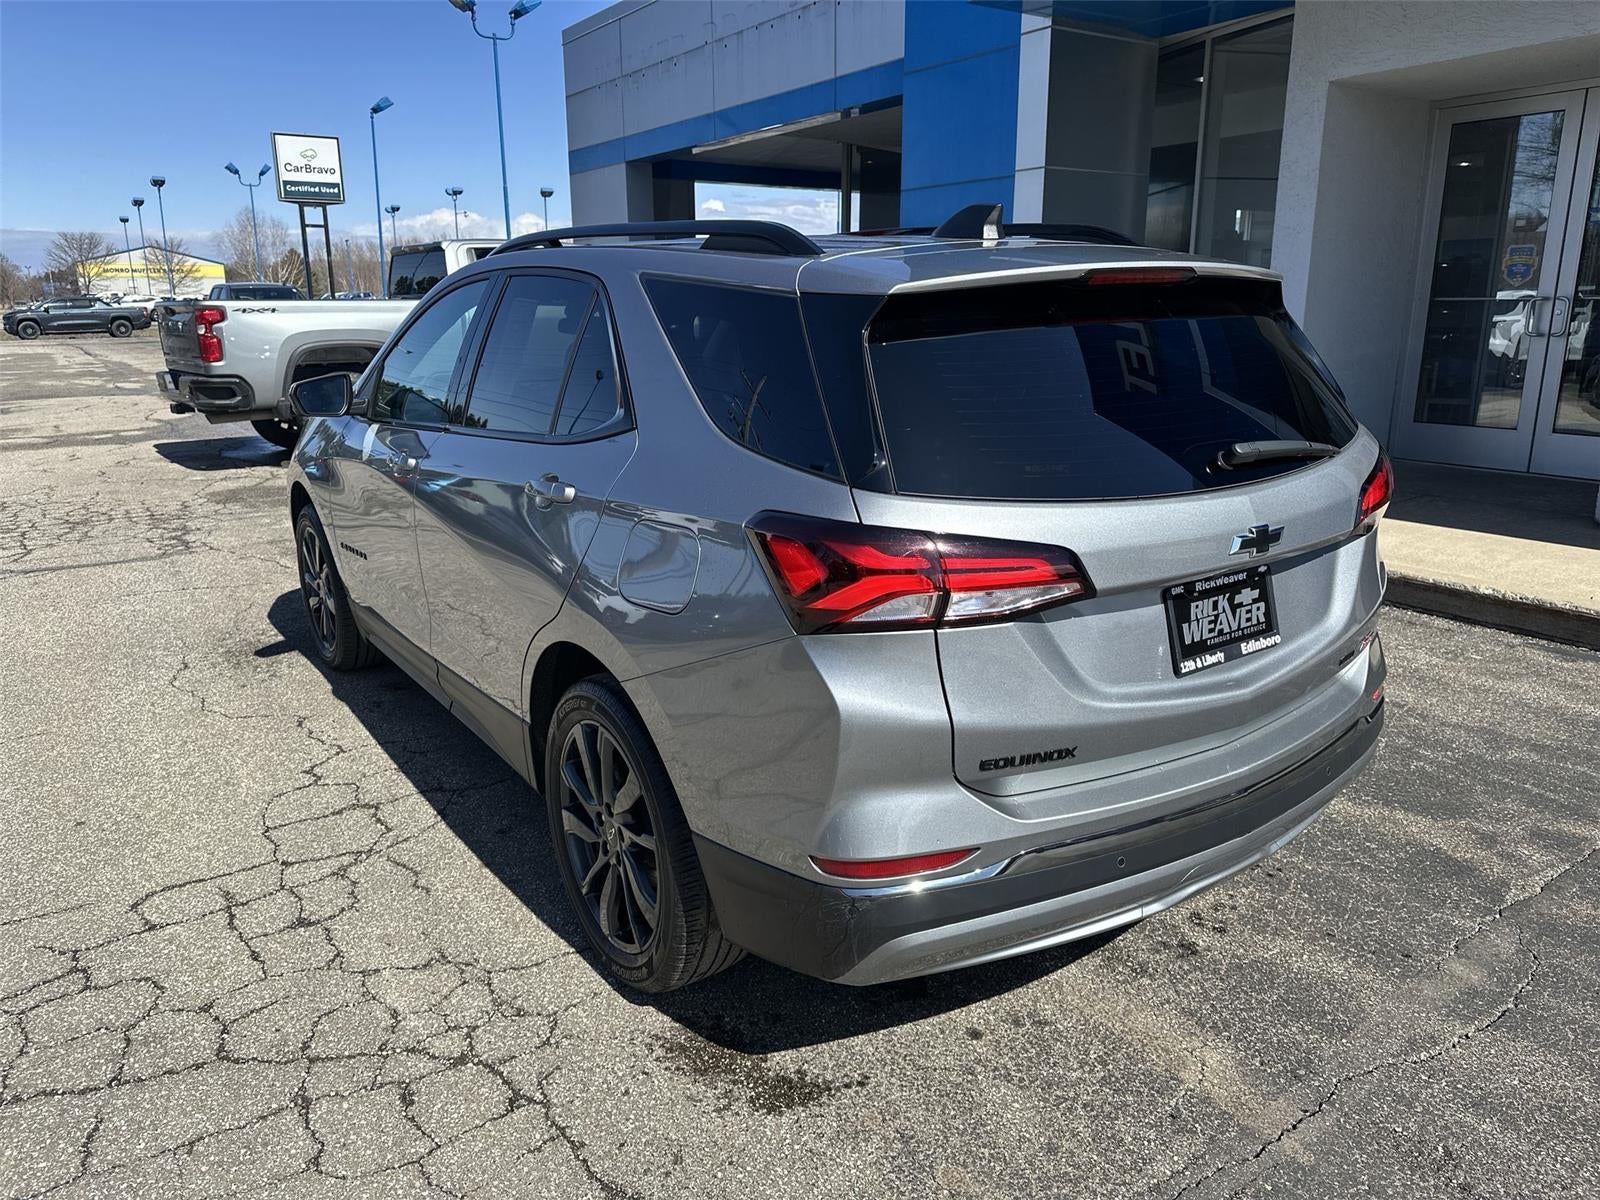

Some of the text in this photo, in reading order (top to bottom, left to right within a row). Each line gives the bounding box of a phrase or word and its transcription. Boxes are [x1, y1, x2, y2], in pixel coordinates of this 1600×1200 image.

[284, 162, 336, 175] CarBravo
[286, 184, 339, 194] Certified Used
[1171, 585, 1185, 596] GMC
[1195, 572, 1248, 592] RickWeaver
[1190, 593, 1231, 621] RICK
[1182, 601, 1266, 645] WEAVER
[1207, 622, 1267, 646] FAMOUS FOR SERVICE
[1240, 634, 1281, 655] Edinboro
[1180, 658, 1196, 674] 12th
[1202, 651, 1225, 667] Liberty
[979, 745, 1078, 772] EQUINOX
